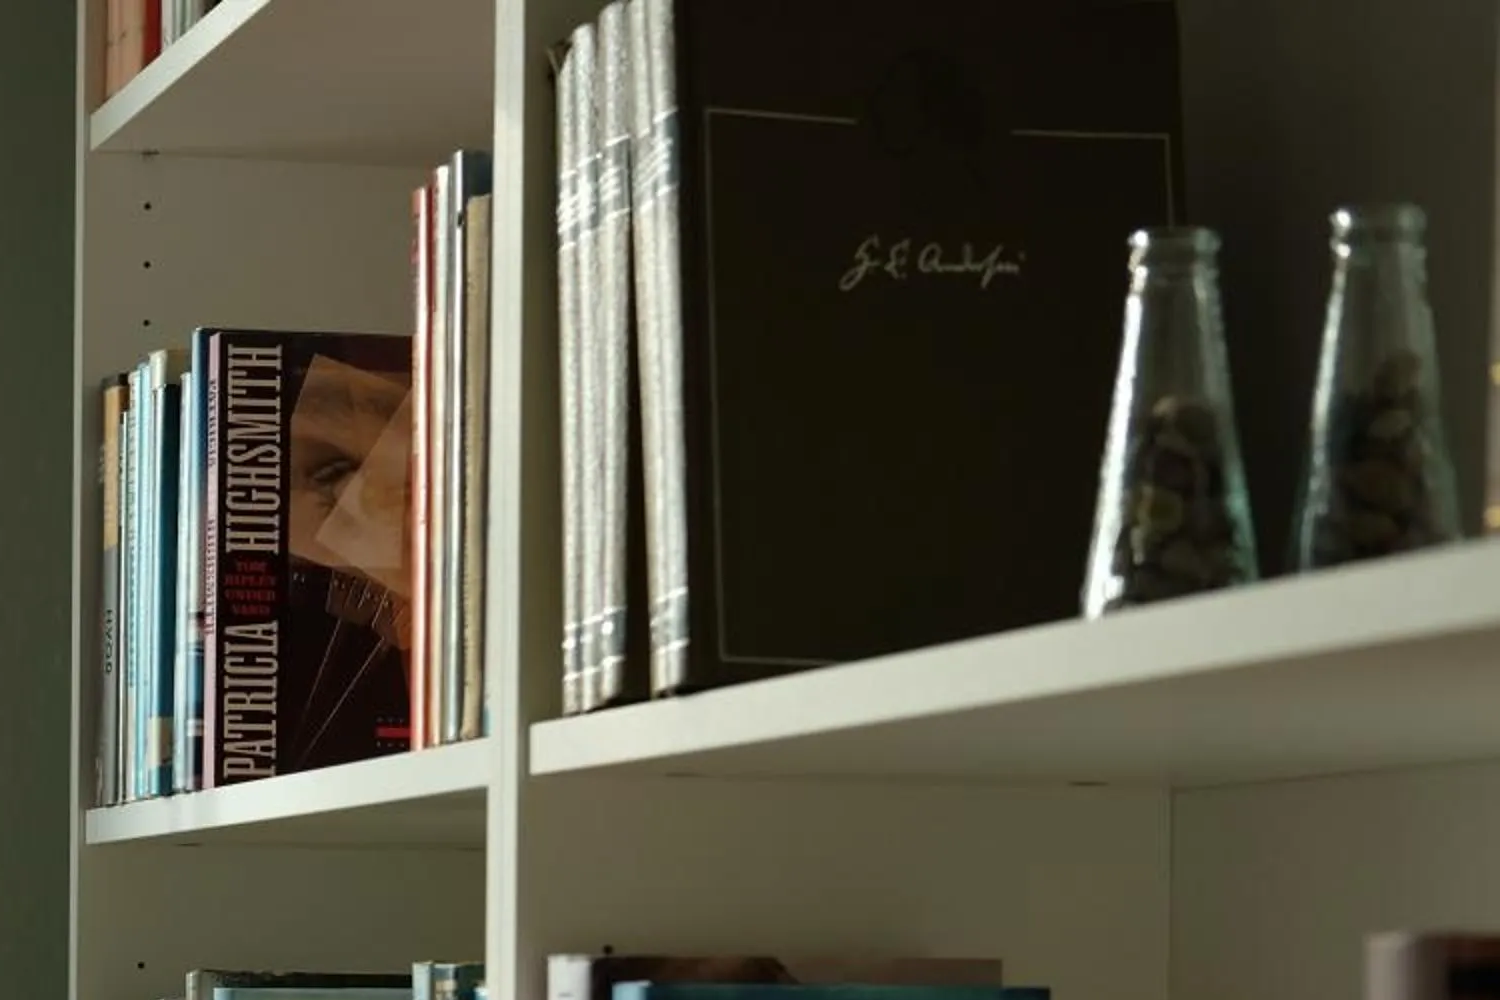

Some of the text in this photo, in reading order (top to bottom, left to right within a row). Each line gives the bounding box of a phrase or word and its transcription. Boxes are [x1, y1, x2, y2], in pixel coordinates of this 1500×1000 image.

[222, 343, 284, 779] PATRICIA HIGHSMITH
[224, 573, 277, 588] RIPLEY
